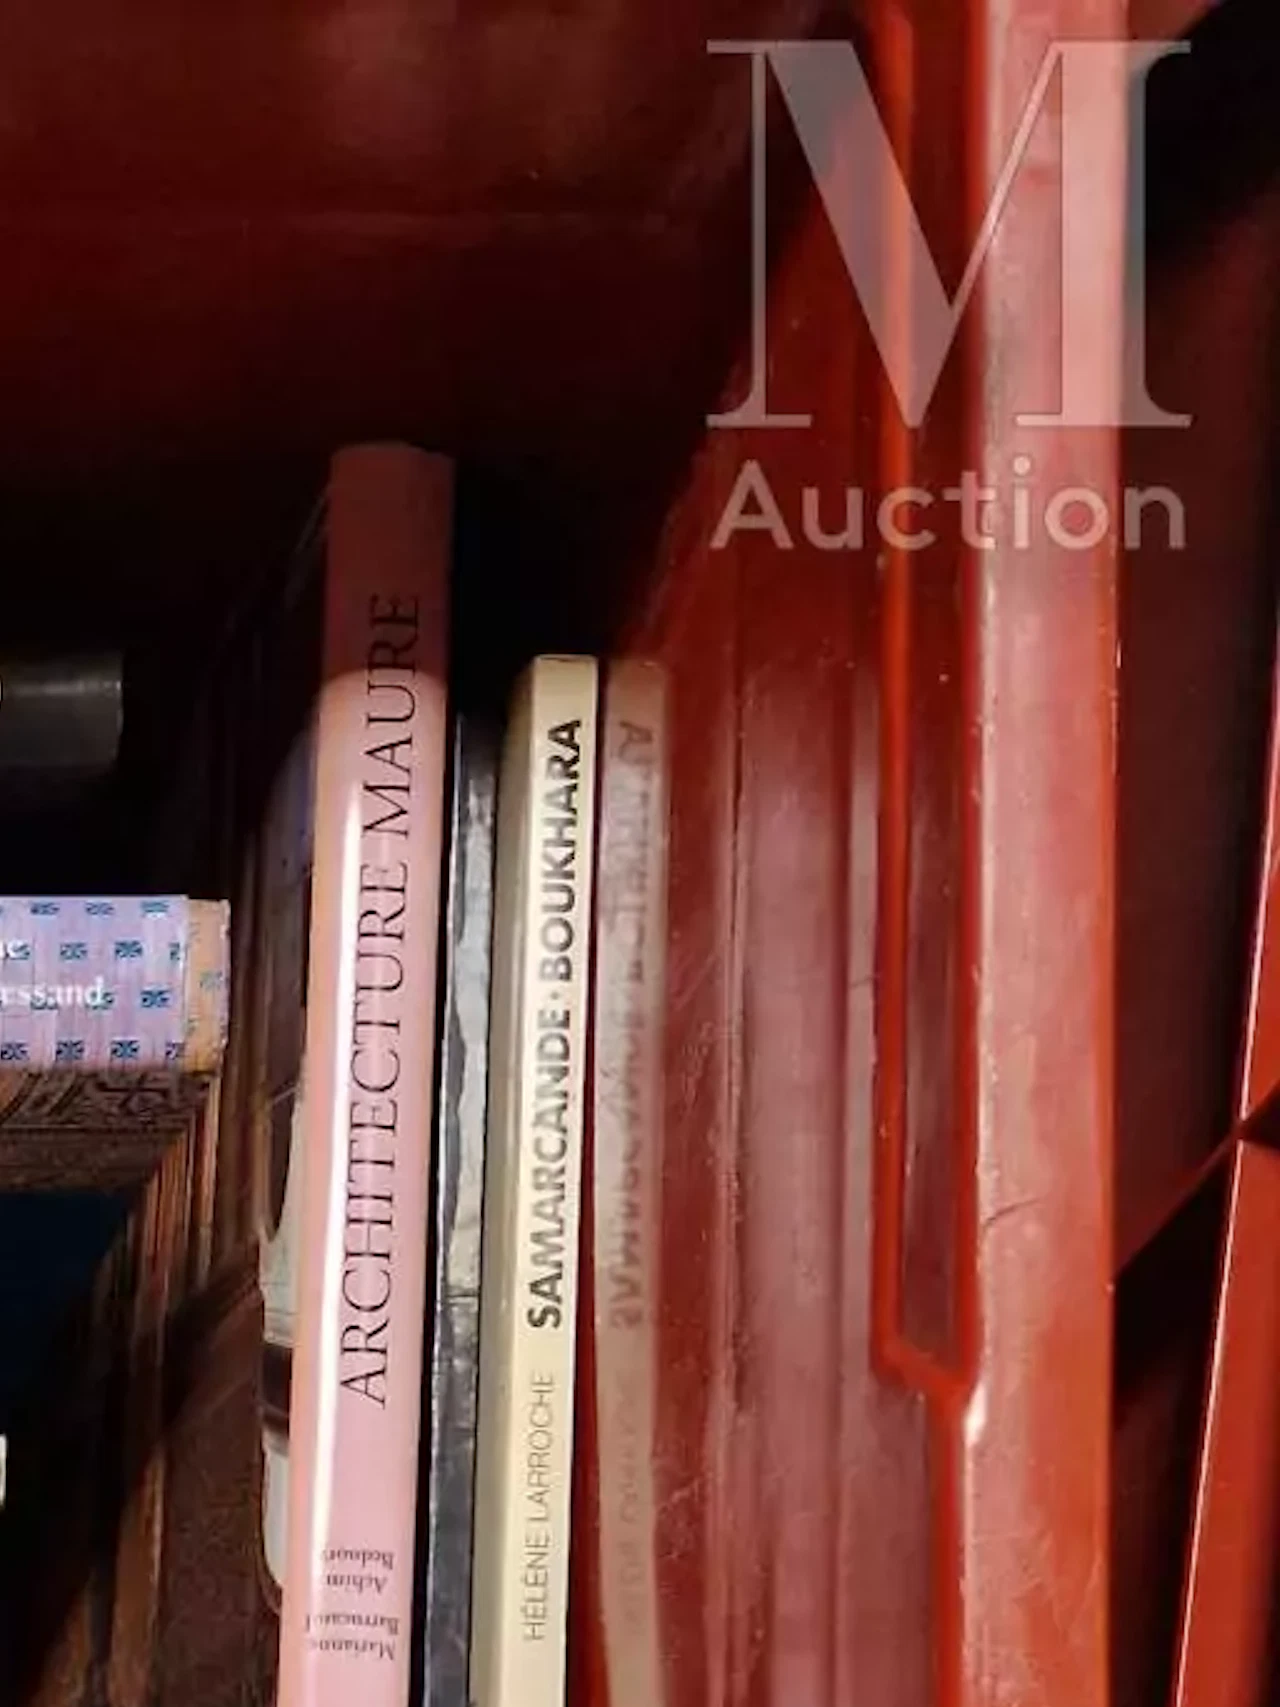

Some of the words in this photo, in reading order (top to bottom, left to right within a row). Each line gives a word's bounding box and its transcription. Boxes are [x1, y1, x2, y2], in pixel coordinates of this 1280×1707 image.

[361, 593, 422, 841] MAURE
[538, 718, 584, 983] BOUKHARA
[338, 861, 412, 1412] ARCHITECTURE
[525, 1008, 573, 1331] SAMARCANDE
[522, 1370, 556, 1524] LARROCHE
